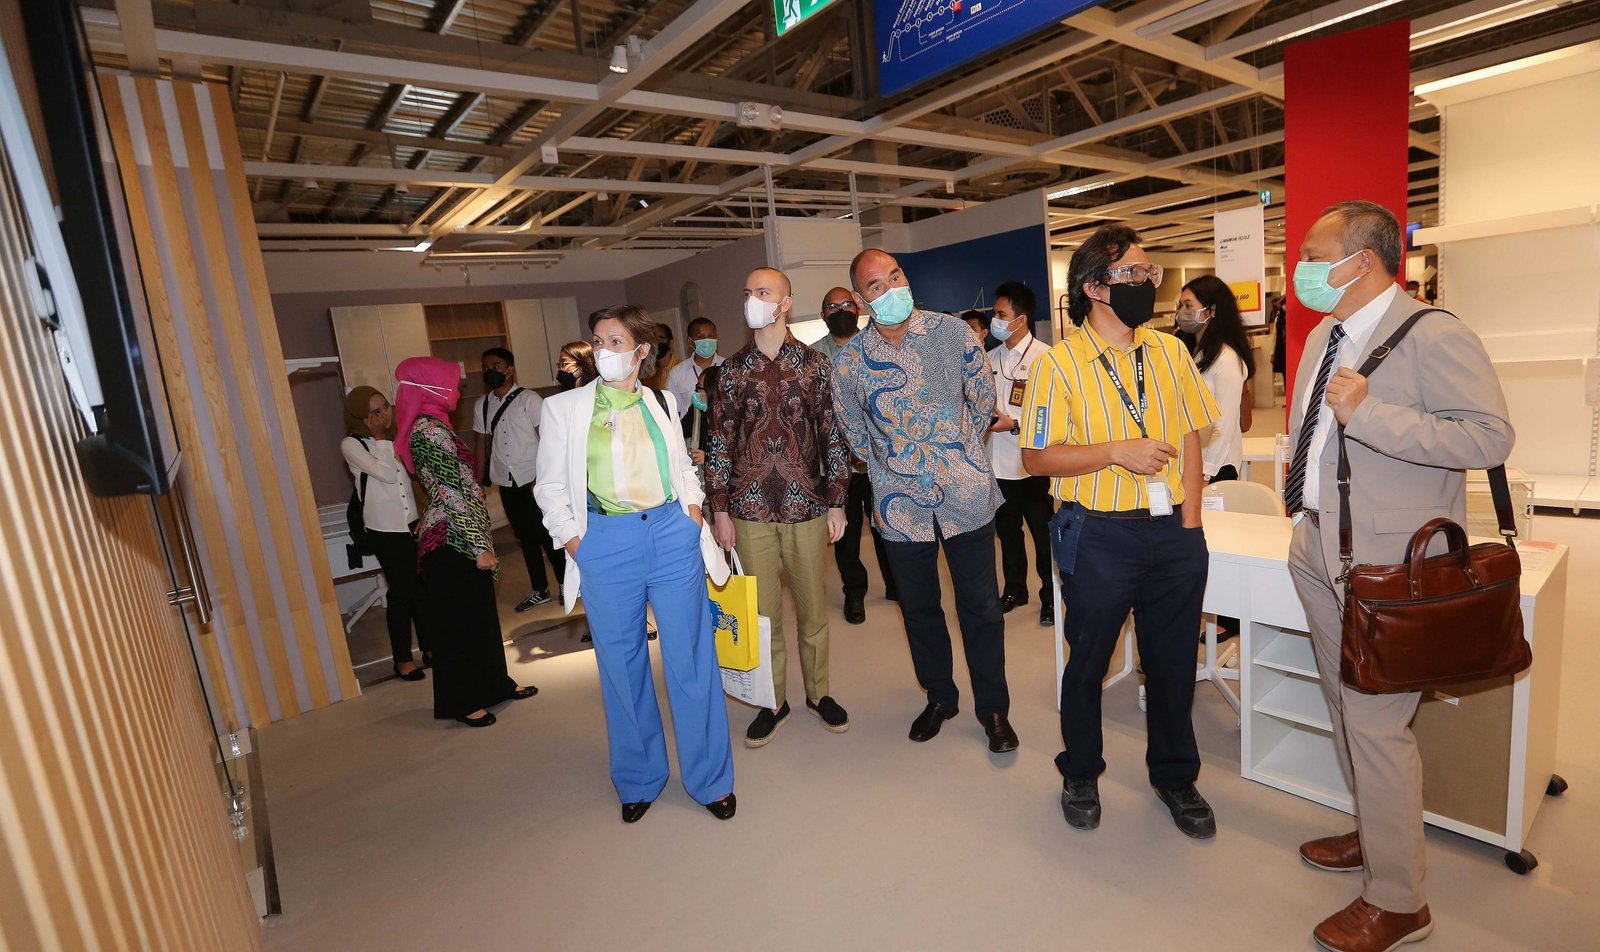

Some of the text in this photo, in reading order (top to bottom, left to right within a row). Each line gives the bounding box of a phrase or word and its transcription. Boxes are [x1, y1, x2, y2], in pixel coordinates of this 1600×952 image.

[1108, 370, 1122, 389] IKEA
[1036, 408, 1044, 435] IKEA
[1128, 403, 1141, 423] IKEA
